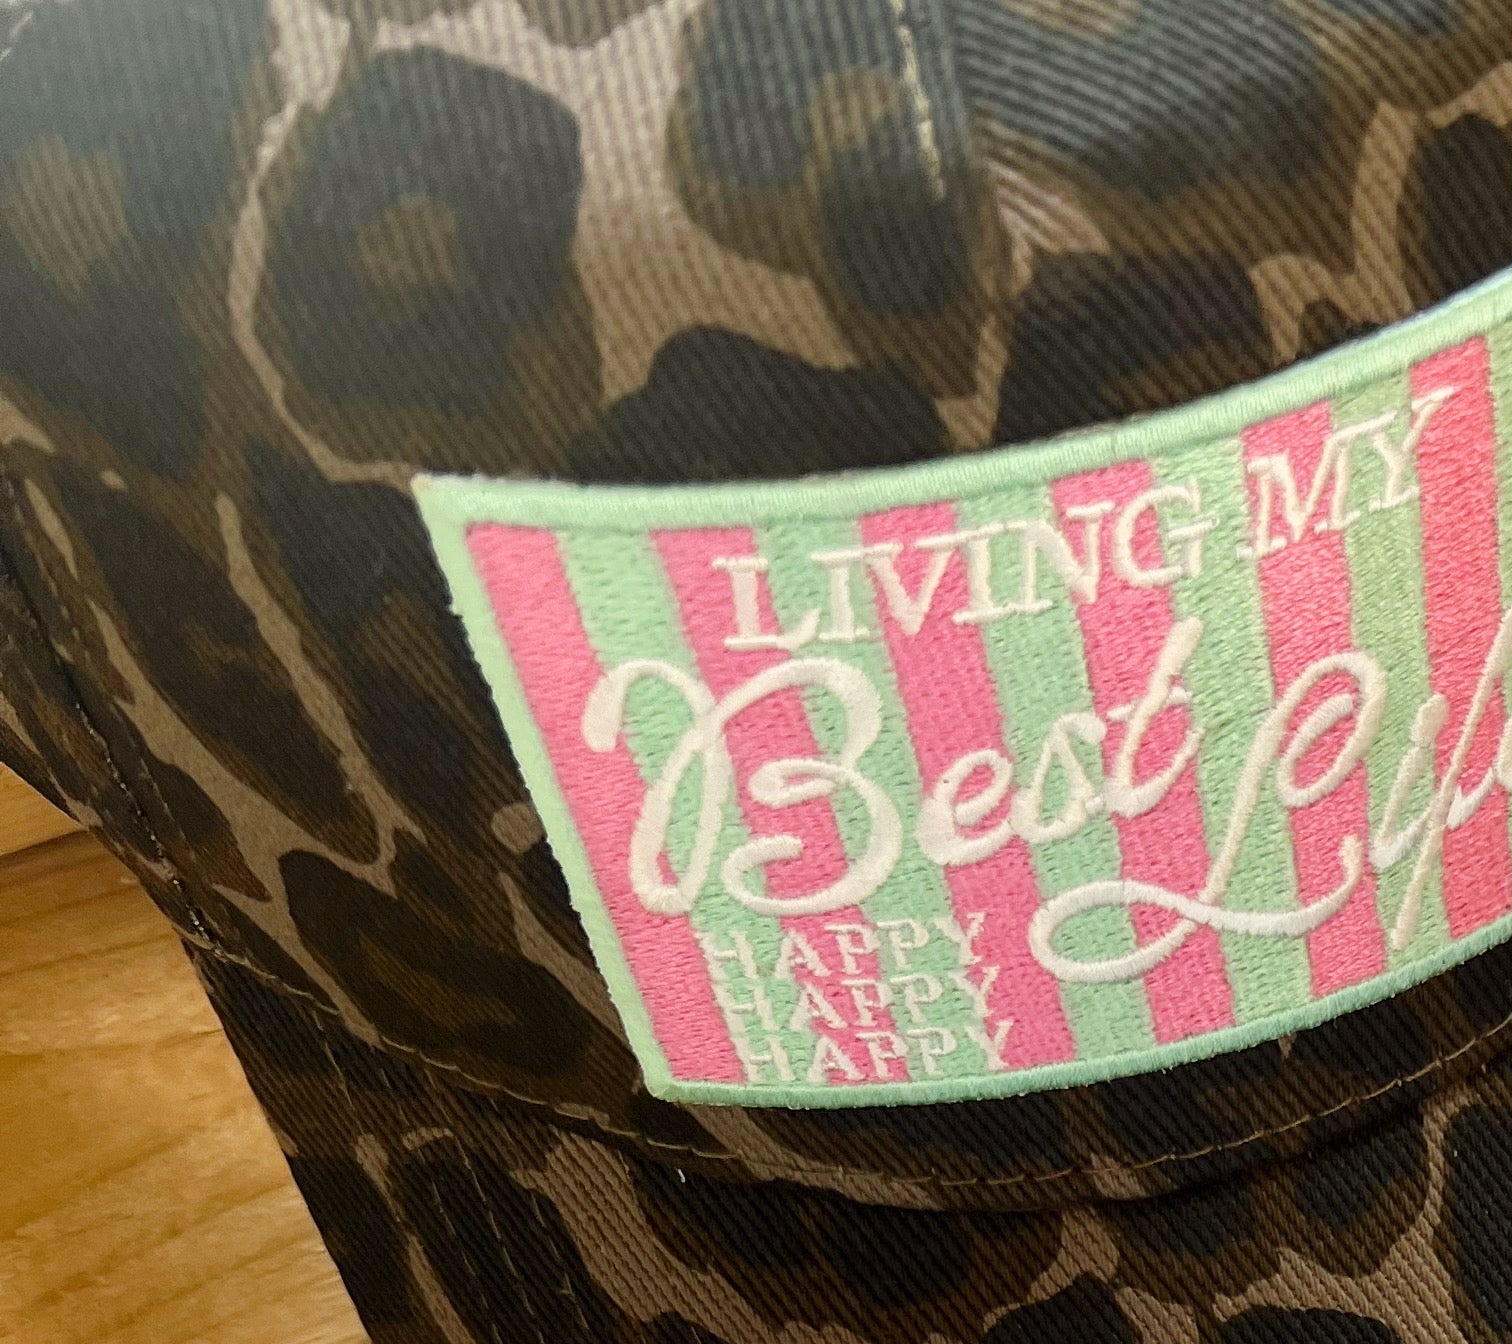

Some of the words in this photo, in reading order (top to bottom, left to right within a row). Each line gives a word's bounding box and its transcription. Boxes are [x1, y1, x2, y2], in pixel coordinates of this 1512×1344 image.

[713, 484, 1216, 651] LIVING
[1239, 387, 1455, 562] MY
[581, 617, 1203, 917] Best
[694, 911, 986, 980] HAPPY
[712, 964, 1001, 1033] HAPPY
[732, 1018, 1014, 1083] HAPPY
